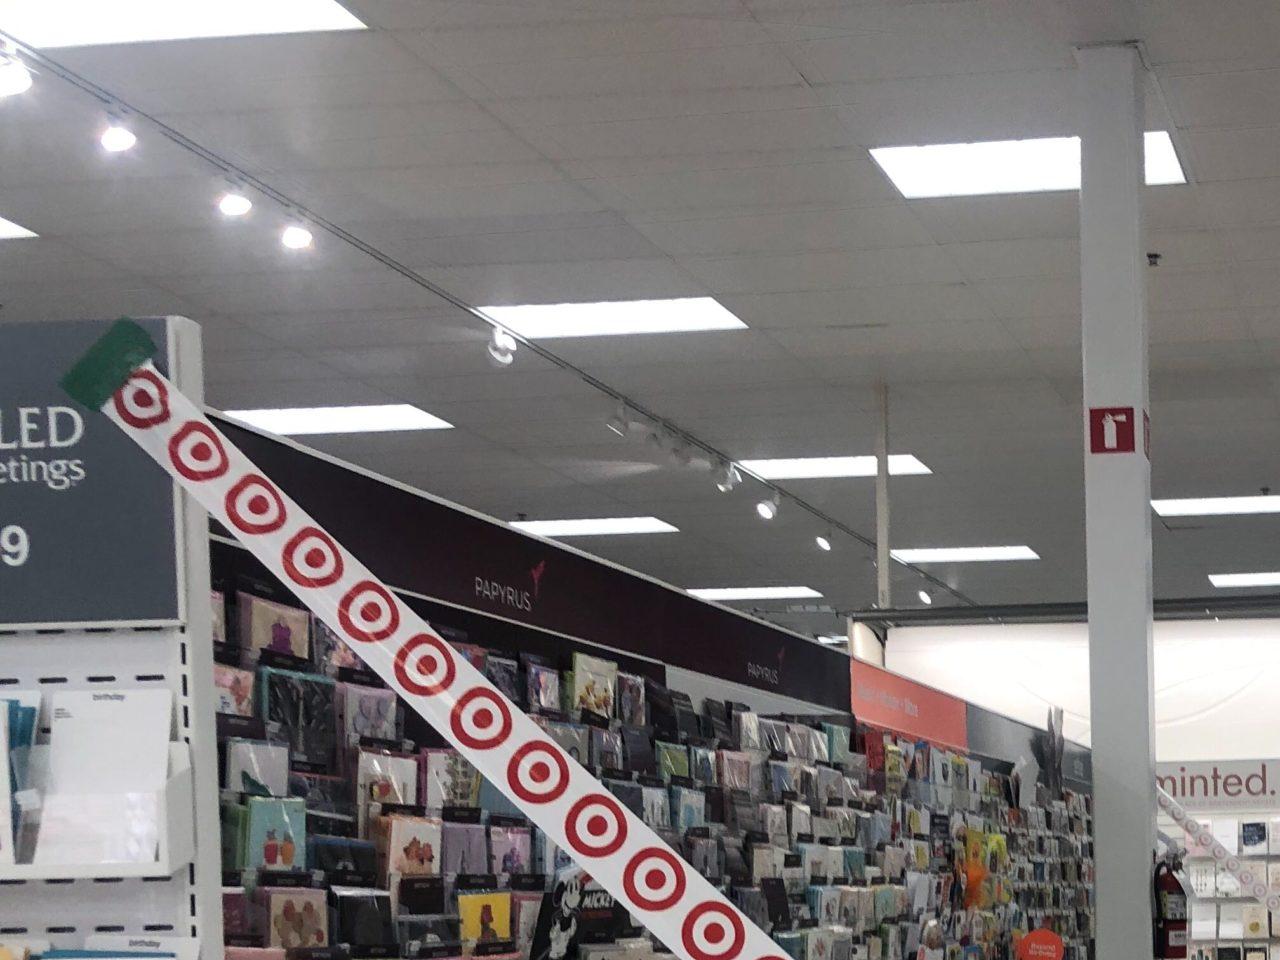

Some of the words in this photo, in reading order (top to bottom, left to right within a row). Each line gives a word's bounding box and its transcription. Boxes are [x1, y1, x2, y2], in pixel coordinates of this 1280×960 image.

[474, 576, 532, 613] PAPYRUS
[747, 662, 779, 685] PAPYRUS
[1156, 764, 1276, 797] minted.
[582, 892, 615, 908] MICKEY
